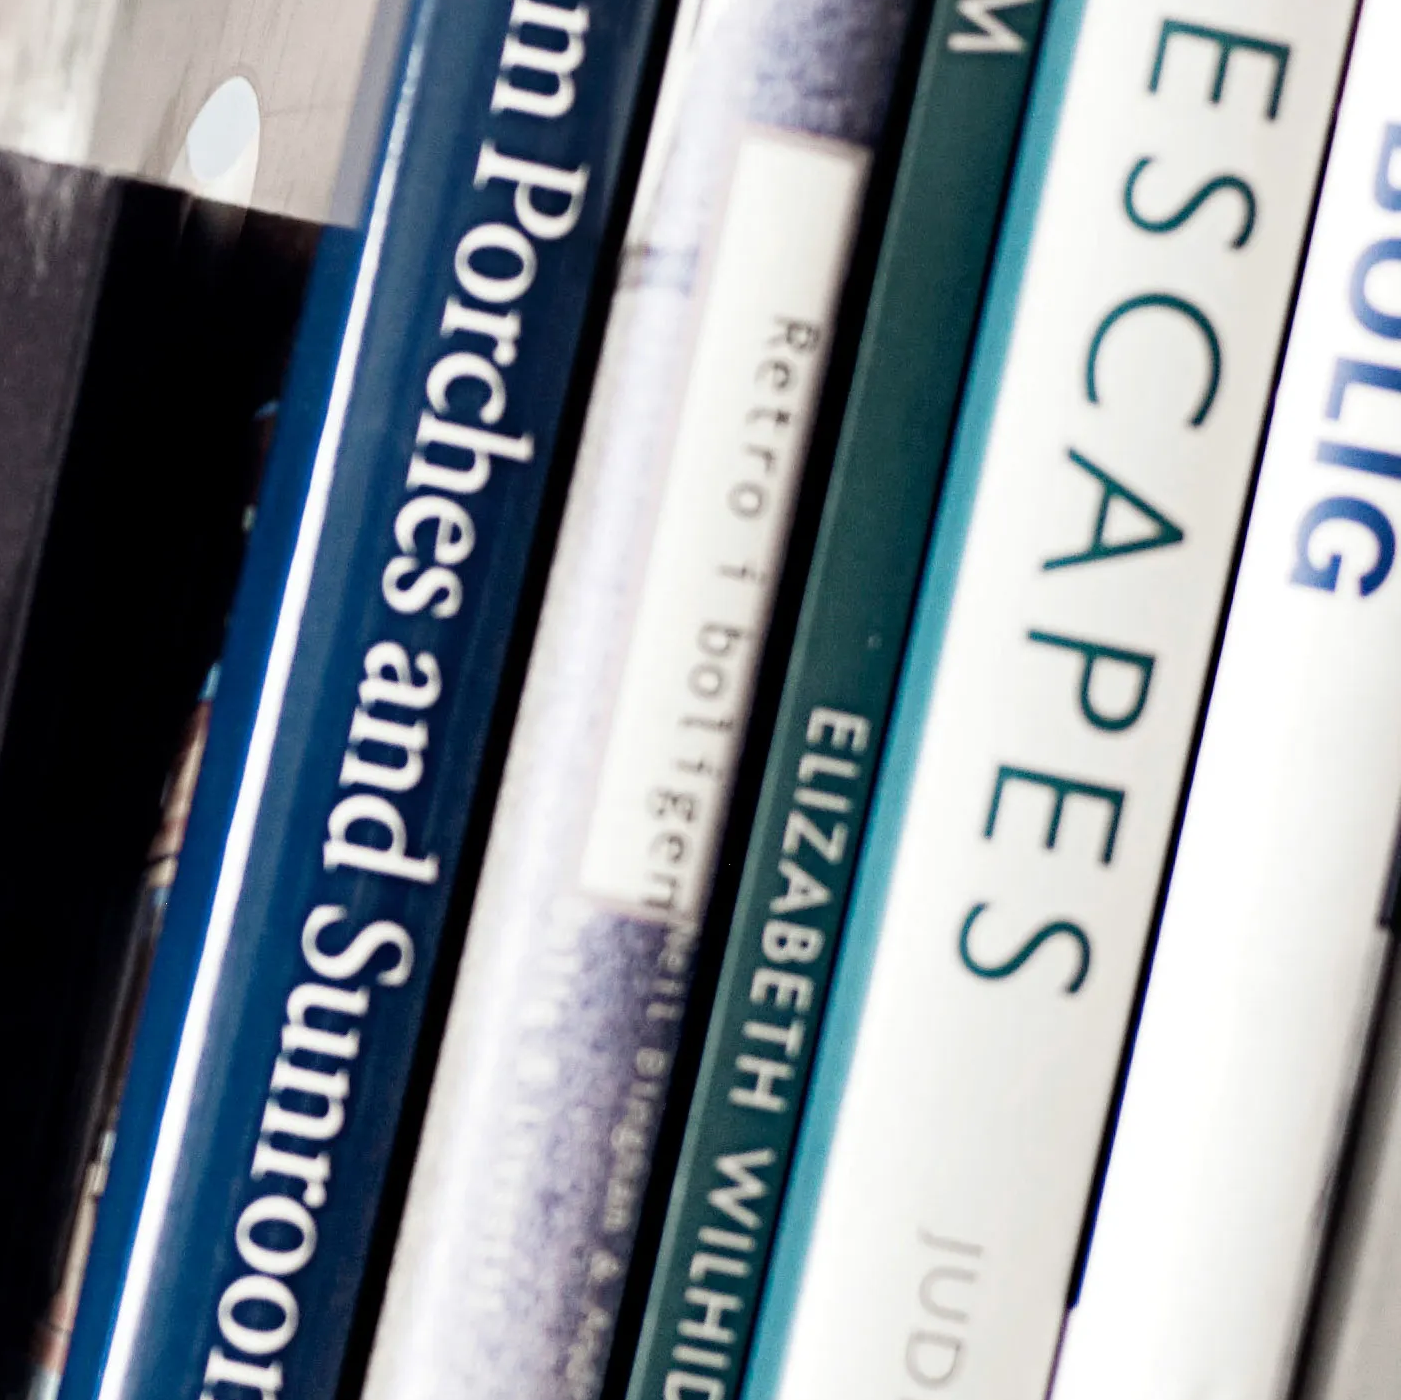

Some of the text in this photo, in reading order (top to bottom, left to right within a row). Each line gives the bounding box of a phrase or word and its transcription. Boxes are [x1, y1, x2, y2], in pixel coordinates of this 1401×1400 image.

[381, 143, 588, 617] Porches
[727, 315, 821, 521] Retro
[957, 19, 1291, 995] ESCAPES
[1288, 122, 1401, 599] OLIG
[322, 641, 441, 883] and
[646, 619, 750, 913] boligen
[729, 707, 870, 1112] ELIZABETH
